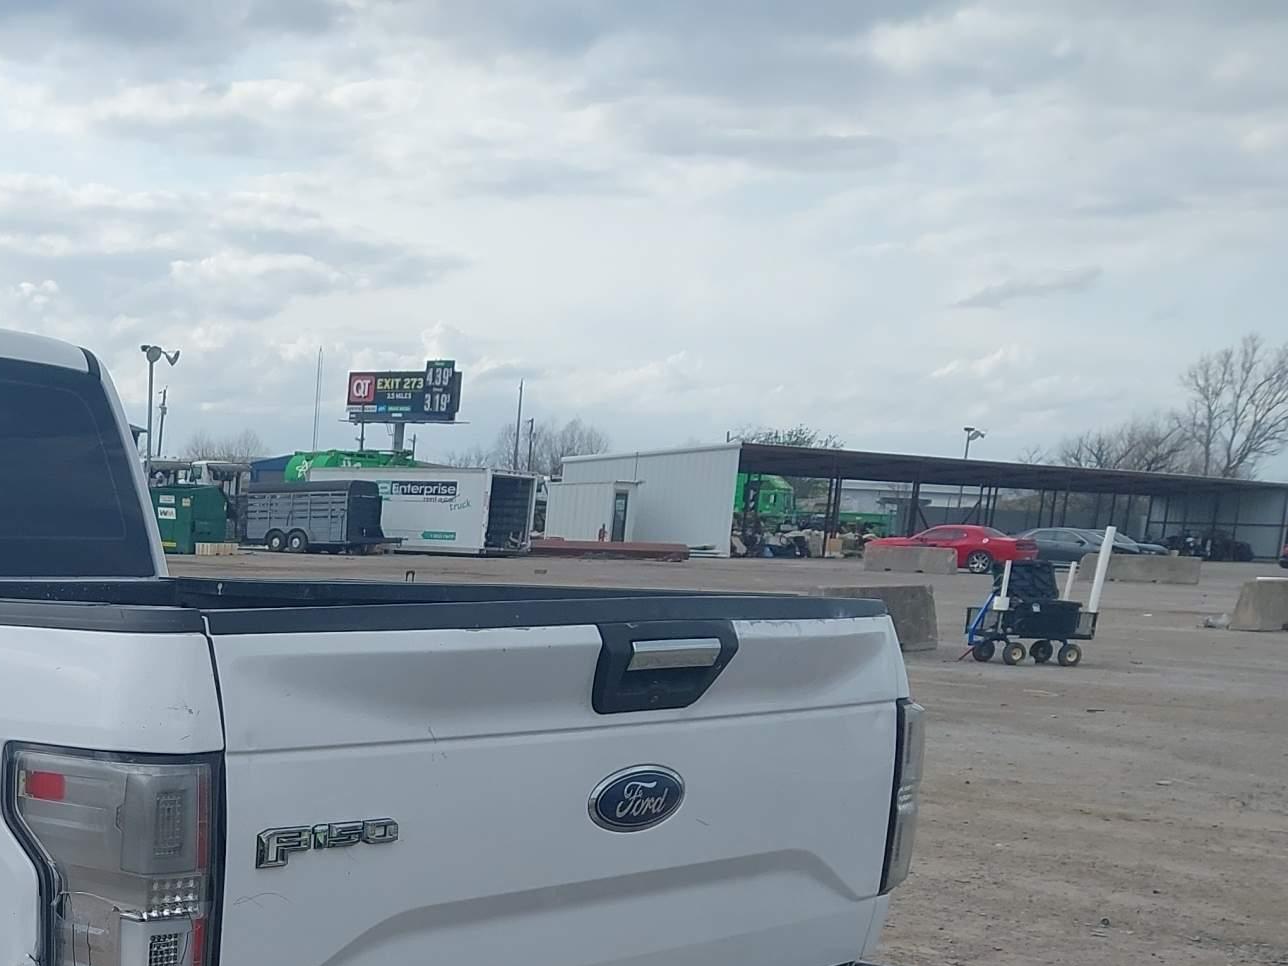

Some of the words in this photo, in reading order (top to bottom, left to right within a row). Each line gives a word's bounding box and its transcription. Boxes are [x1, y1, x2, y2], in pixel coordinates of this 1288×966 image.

[353, 379, 371, 398] QT
[376, 378, 402, 389] EXIT
[403, 377, 424, 389] 273
[392, 483, 456, 496] Enterprise
[449, 498, 471, 511] truck
[616, 781, 669, 818] Ford
